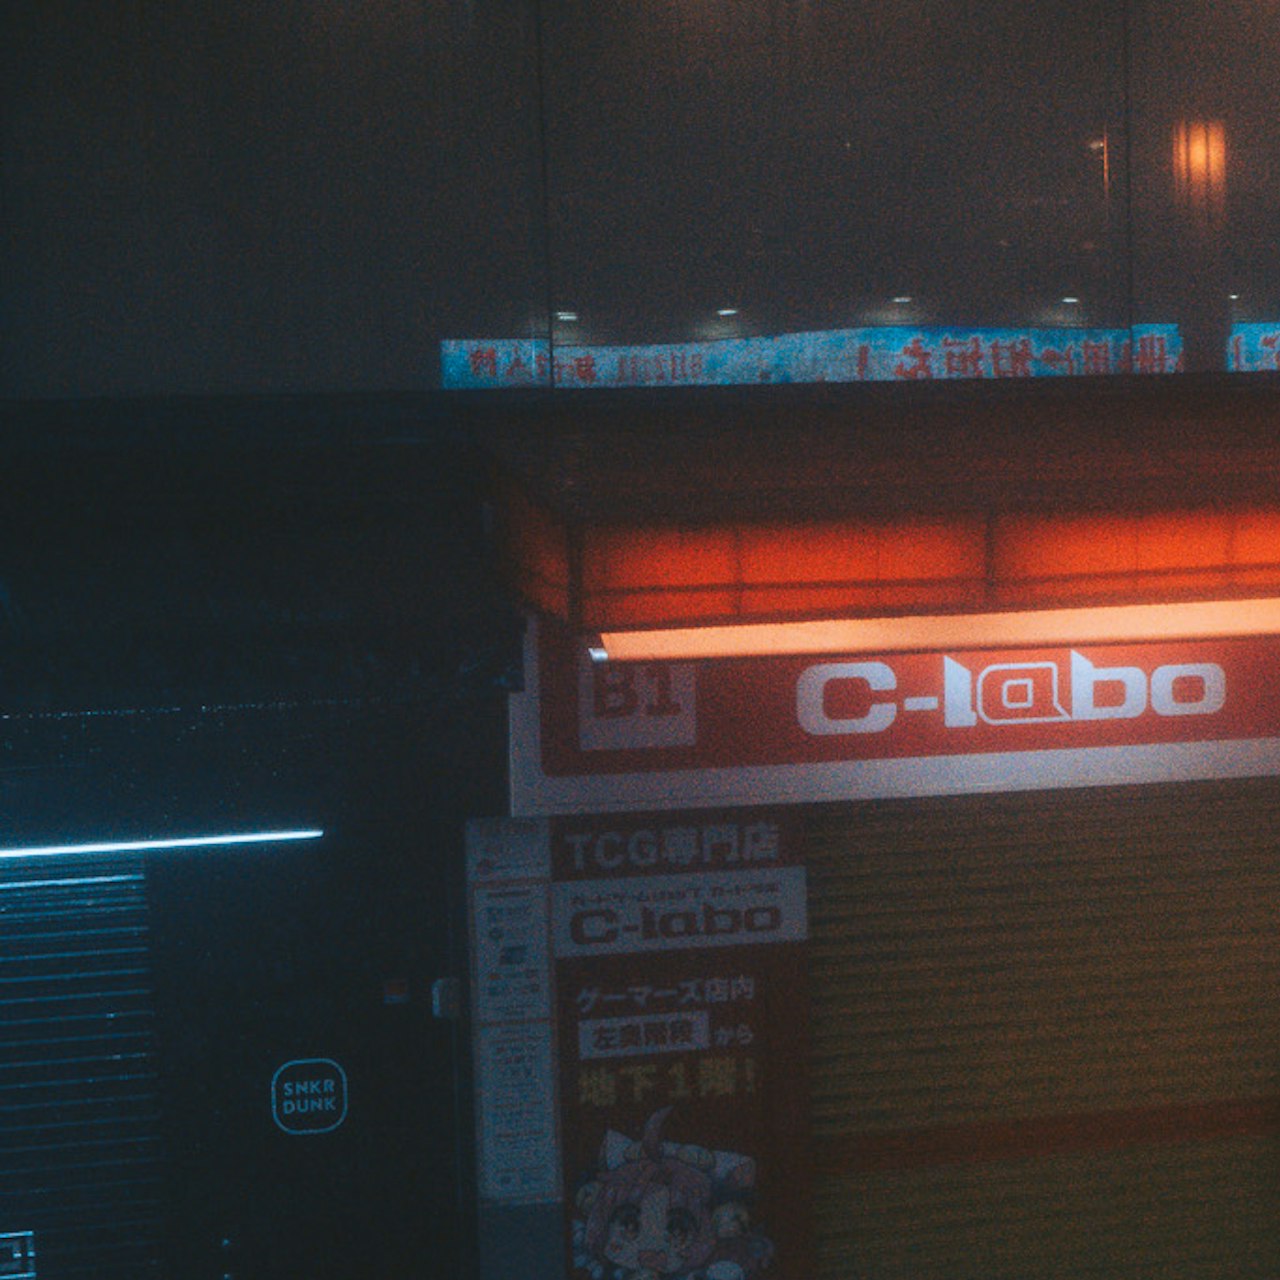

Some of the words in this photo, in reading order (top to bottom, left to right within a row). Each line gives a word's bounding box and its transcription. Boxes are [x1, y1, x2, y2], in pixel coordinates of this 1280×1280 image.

[591, 662, 682, 717] B1
[564, 819, 779, 870] TCG専門店
[283, 1078, 335, 1097] SNKR
[283, 1097, 337, 1115] DUNK
